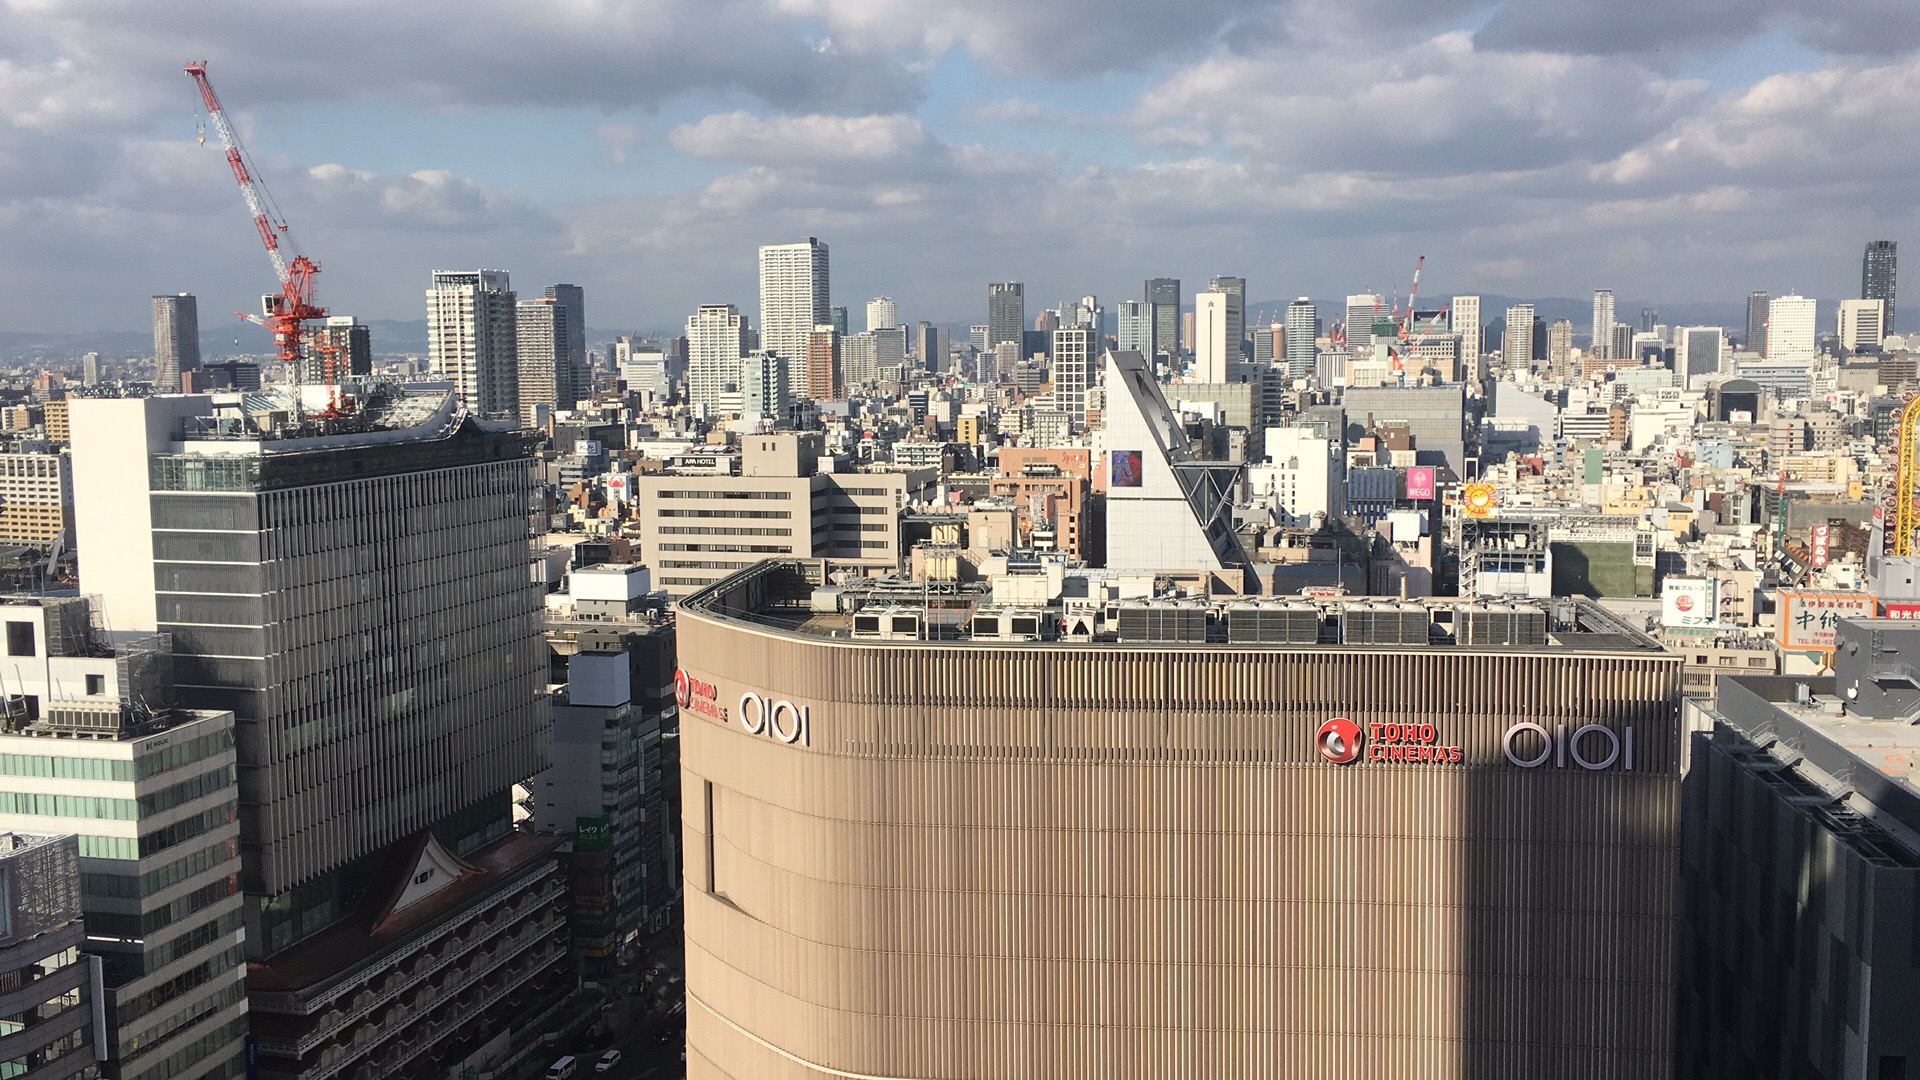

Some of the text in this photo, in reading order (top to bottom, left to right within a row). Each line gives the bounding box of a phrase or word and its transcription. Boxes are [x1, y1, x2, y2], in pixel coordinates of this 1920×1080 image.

[1409, 488, 1431, 497] WEGO
[1370, 722, 1437, 744] TOHO
[1369, 744, 1463, 765] CINEMAS
